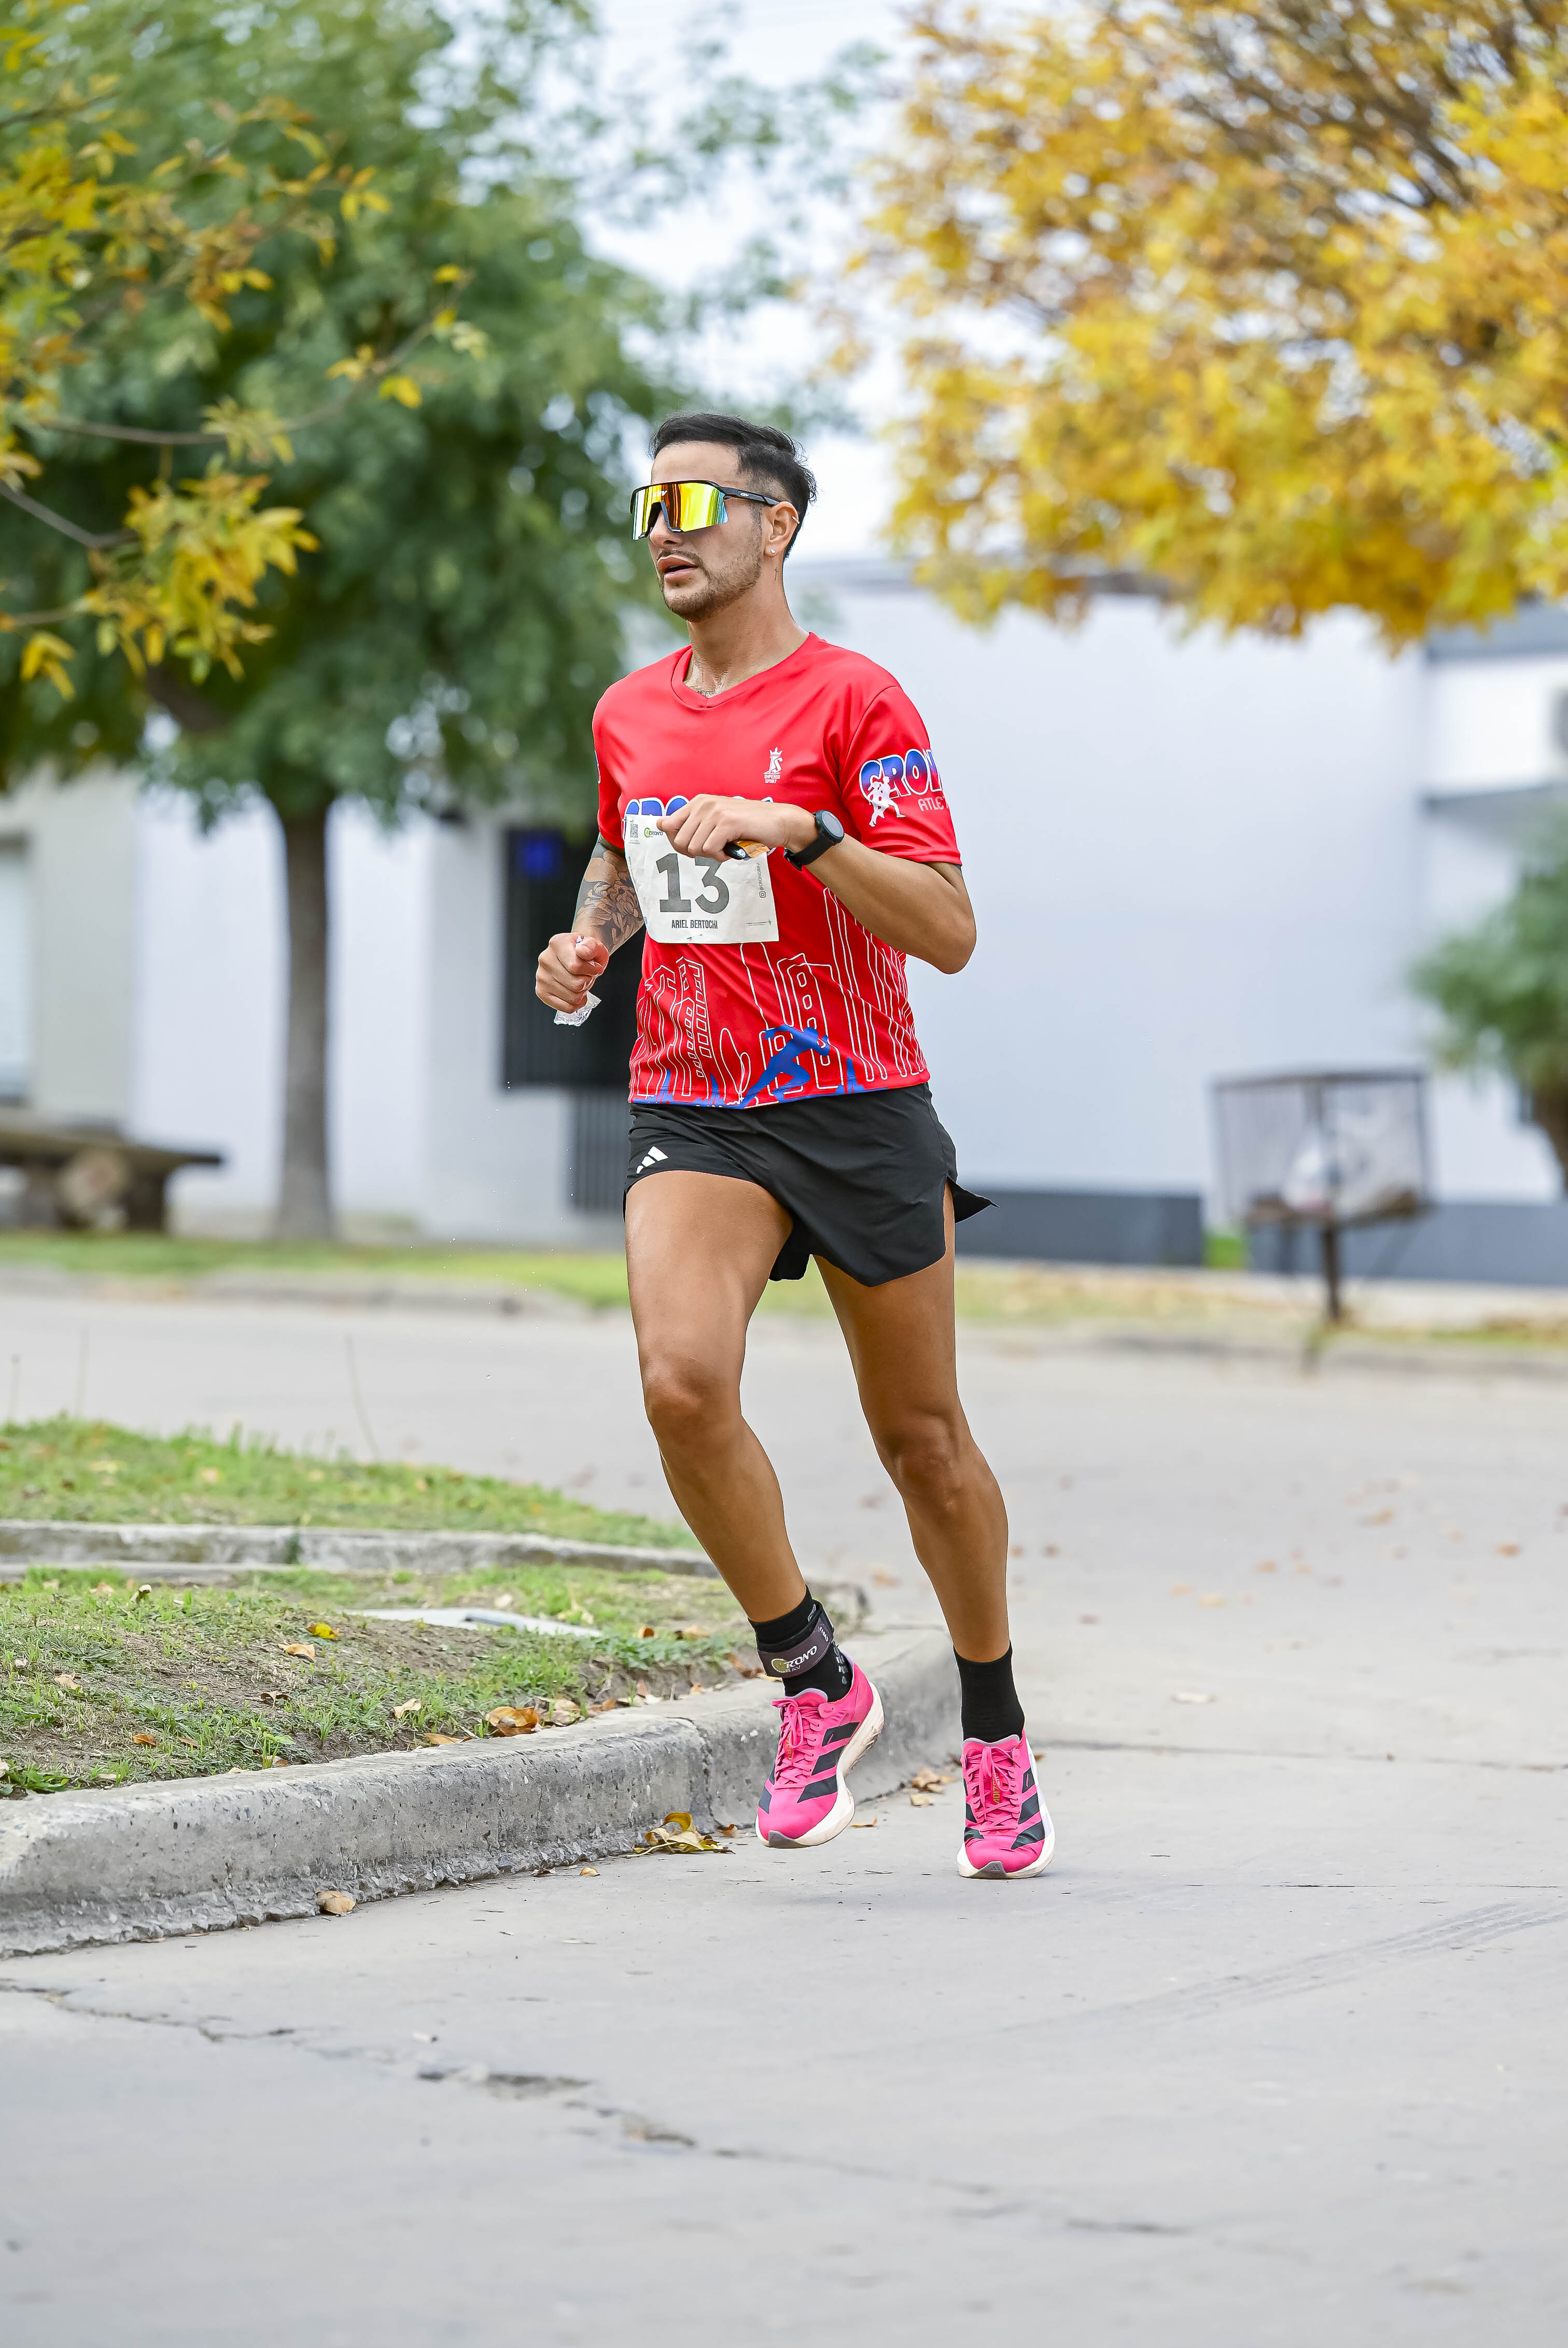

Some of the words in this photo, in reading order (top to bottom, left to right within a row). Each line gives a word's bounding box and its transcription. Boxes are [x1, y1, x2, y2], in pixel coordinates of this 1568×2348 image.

[656, 853, 730, 914] 13
[671, 919, 689, 929] ARIEL
[690, 919, 718, 929] BERTOCHI
[771, 1645, 817, 1673] CRONO
